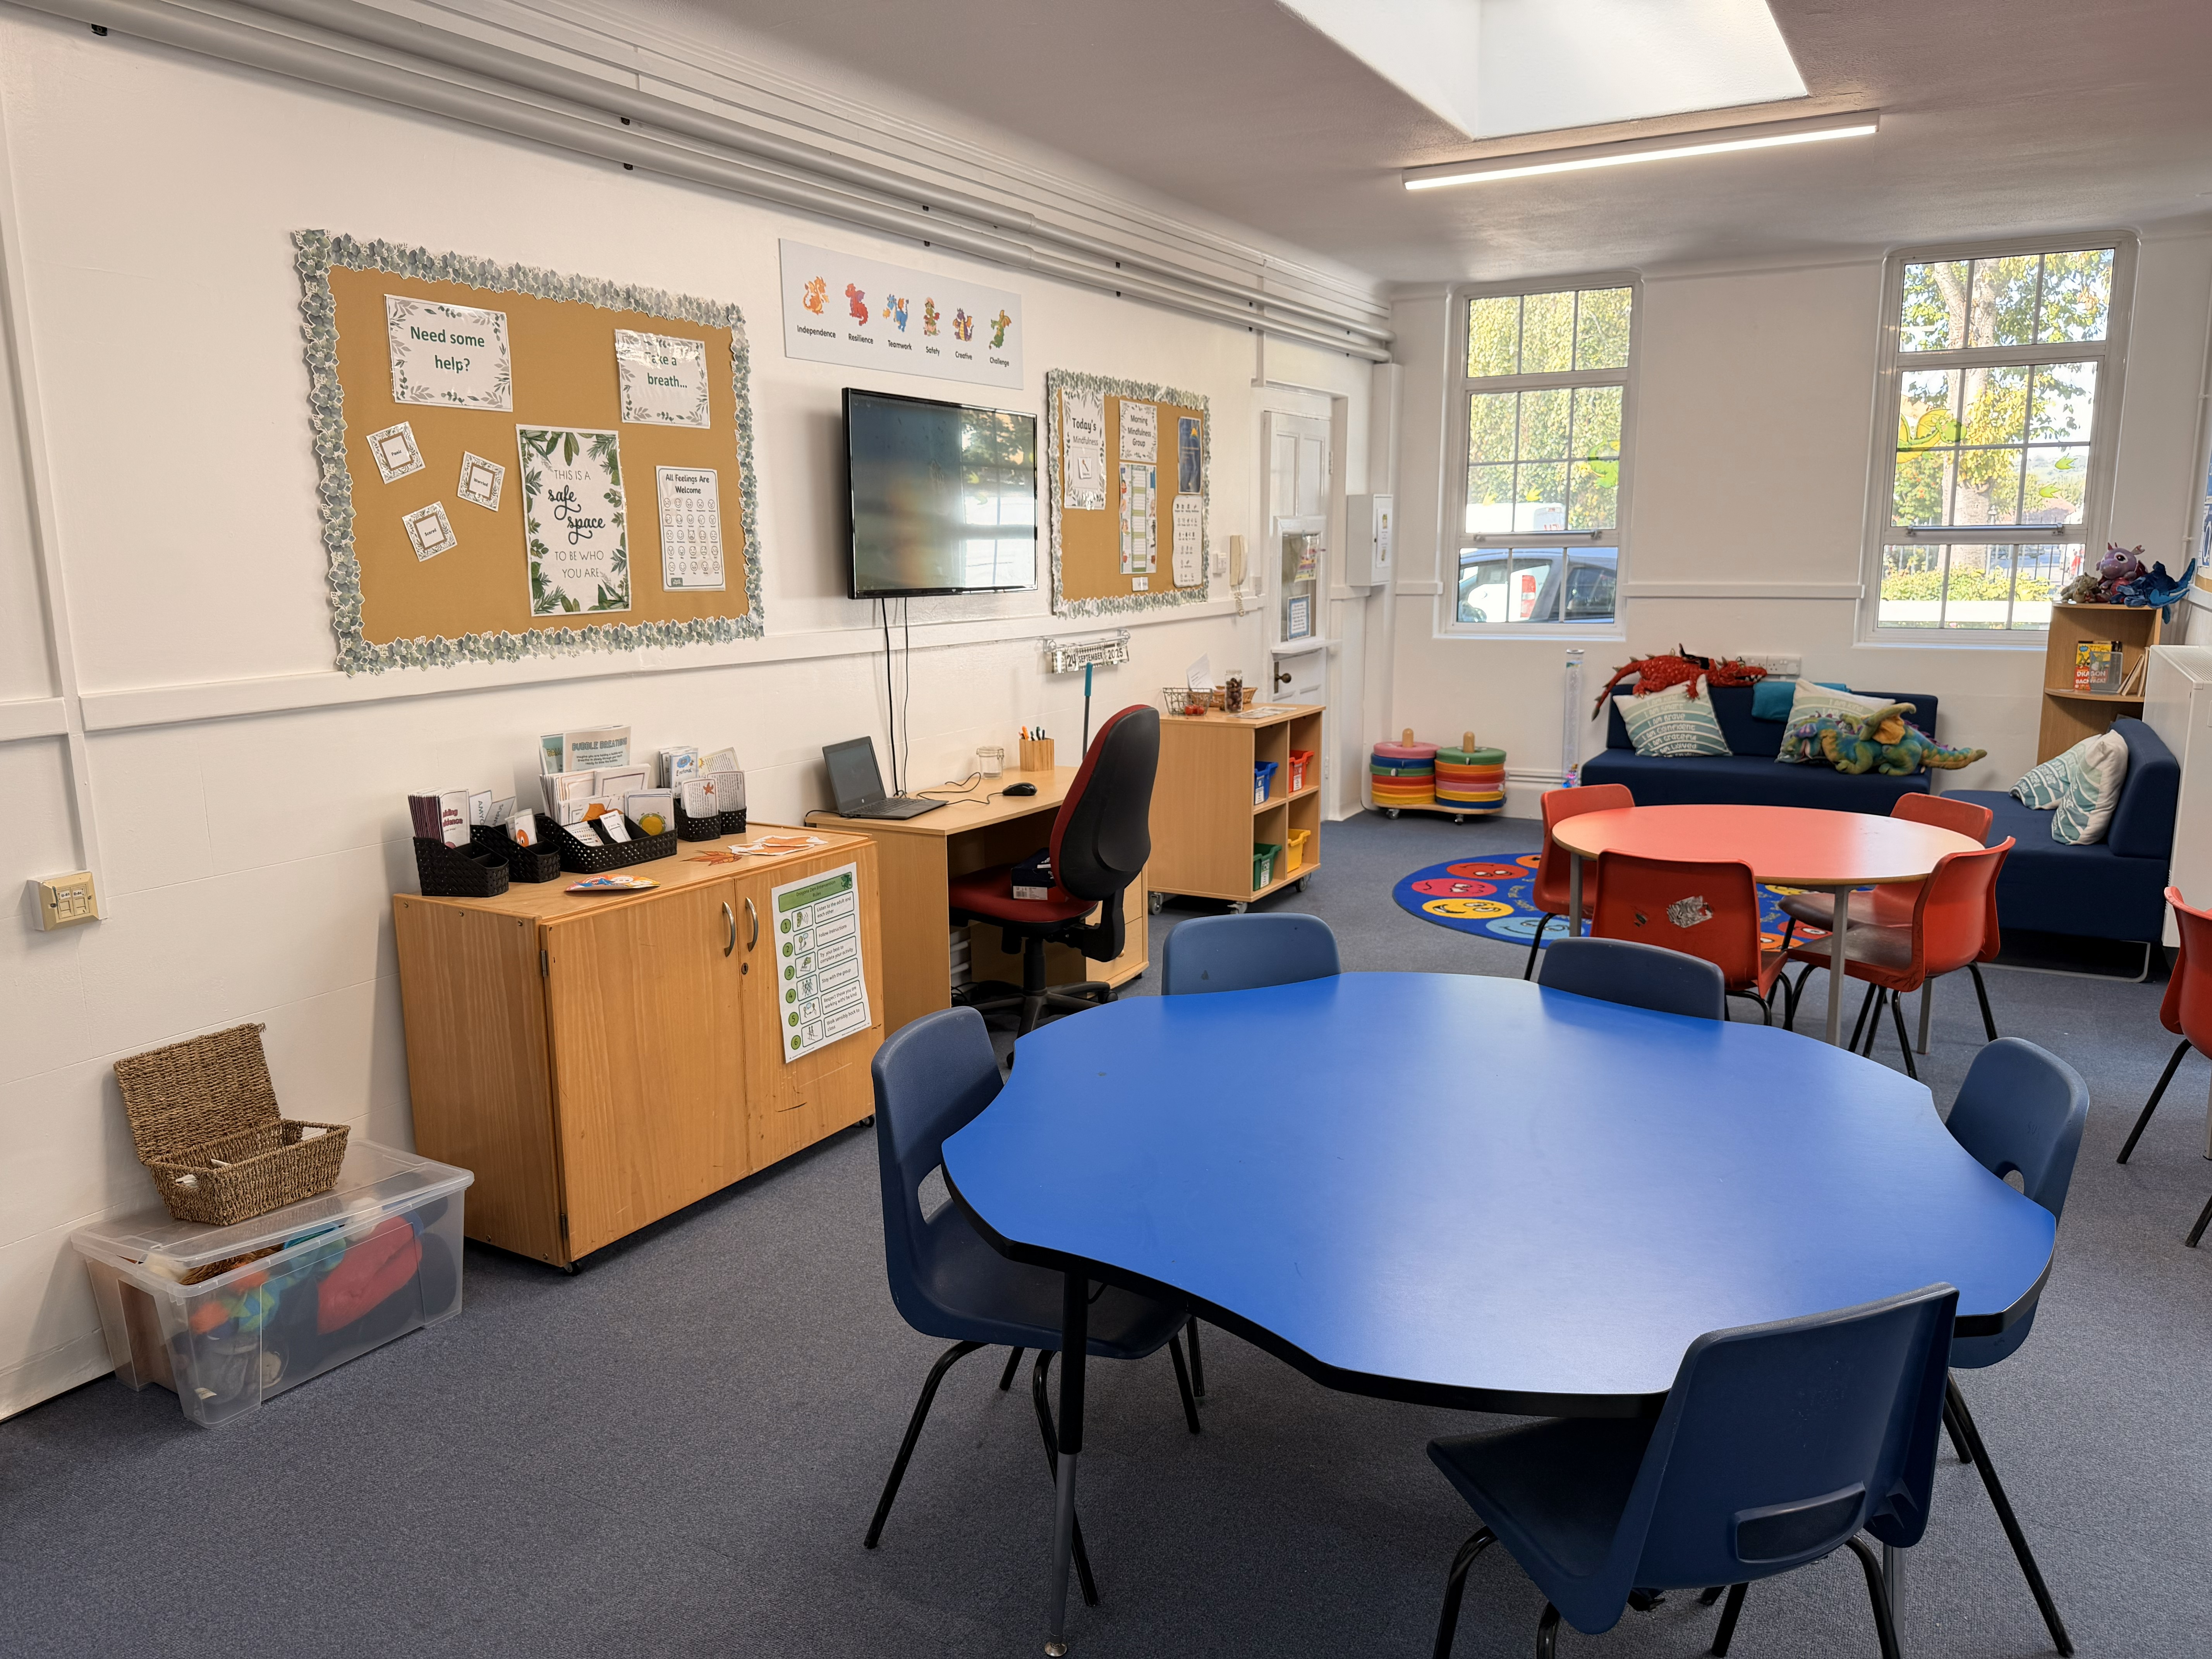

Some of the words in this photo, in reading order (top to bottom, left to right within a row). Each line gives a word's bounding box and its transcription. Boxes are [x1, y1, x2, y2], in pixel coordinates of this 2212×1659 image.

[410, 326, 446, 343] Need
[450, 333, 484, 347] some
[797, 325, 836, 338] Independence
[848, 333, 874, 345] Resilience
[888, 340, 912, 351] Teamwork
[926, 346, 940, 356] Safety
[955, 351, 972, 361] Creative
[434, 355, 470, 374] help?
[672, 357, 677, 366] a
[989, 357, 1009, 367] Challenge
[647, 373, 687, 388] breath...
[1072, 417, 1096, 433] Today's
[1130, 415, 1148, 426] Morning
[1127, 427, 1151, 437] Mindfulness
[1073, 436, 1098, 446] Mindfulness
[1132, 438, 1146, 448] Group
[554, 470, 572, 480] THIS
[575, 470, 582, 480] IS
[585, 471, 591, 480] A
[675, 474, 697, 484] Feelings
[474, 477, 488, 487] Worried
[548, 485, 581, 520] safe
[424, 528, 437, 536] Scared
[567, 516, 605, 545] space
[555, 551, 566, 561] TO
[570, 551, 577, 560] BE
[579, 550, 604, 560] WHO
[562, 568, 581, 578] YOU
[584, 568, 599, 577] ARE
[1067, 653, 1077, 667] 24
[1078, 652, 1103, 663] SEPTEMBER
[1108, 648, 1123, 659] 2025
[572, 741, 598, 751] BUBBLE
[796, 889, 809, 897] Dragons
[817, 880, 836, 890] Intervention
[820, 955, 835, 963] complete
[842, 968, 851, 977] group
[824, 994, 836, 1003] Respect
[835, 1013, 848, 1022] sensibly
